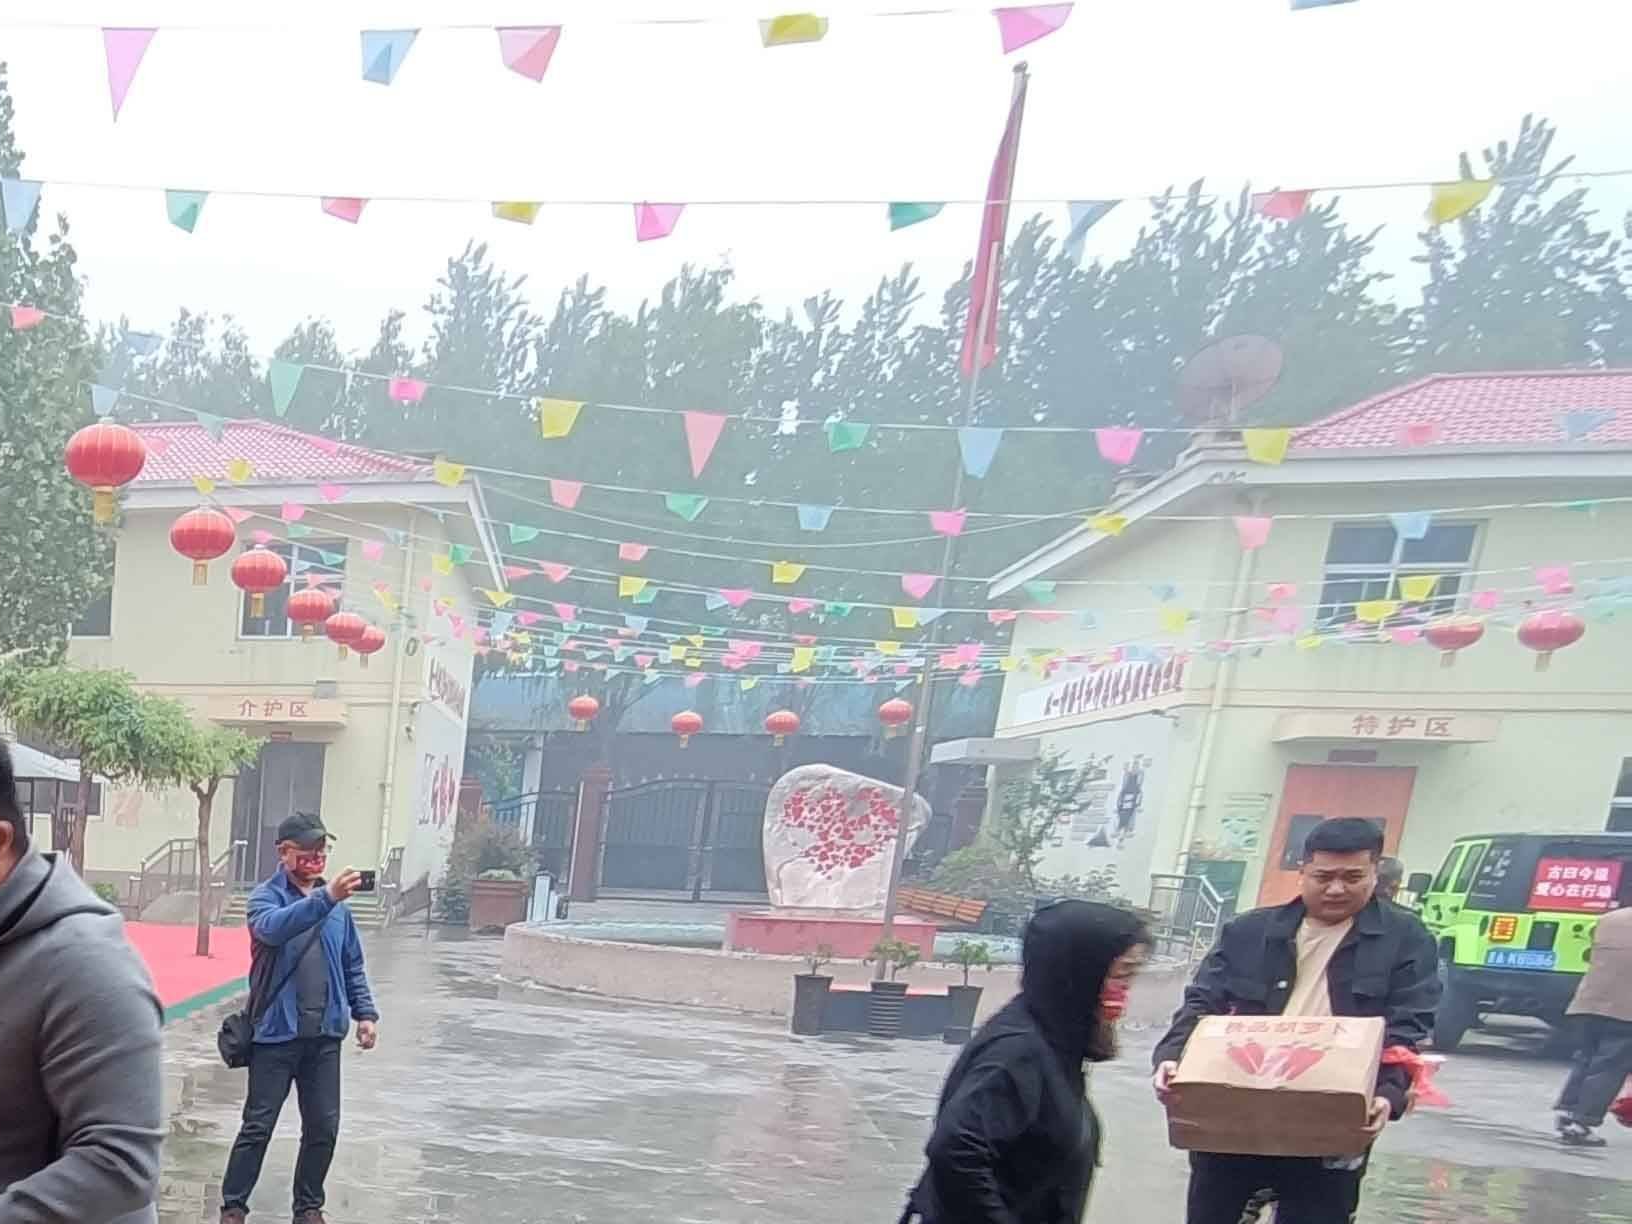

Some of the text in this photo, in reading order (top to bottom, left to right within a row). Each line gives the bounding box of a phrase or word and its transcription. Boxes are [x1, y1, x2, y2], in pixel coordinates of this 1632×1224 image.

[239, 699, 309, 717] 介护区
[1351, 713, 1456, 737] 特护区
